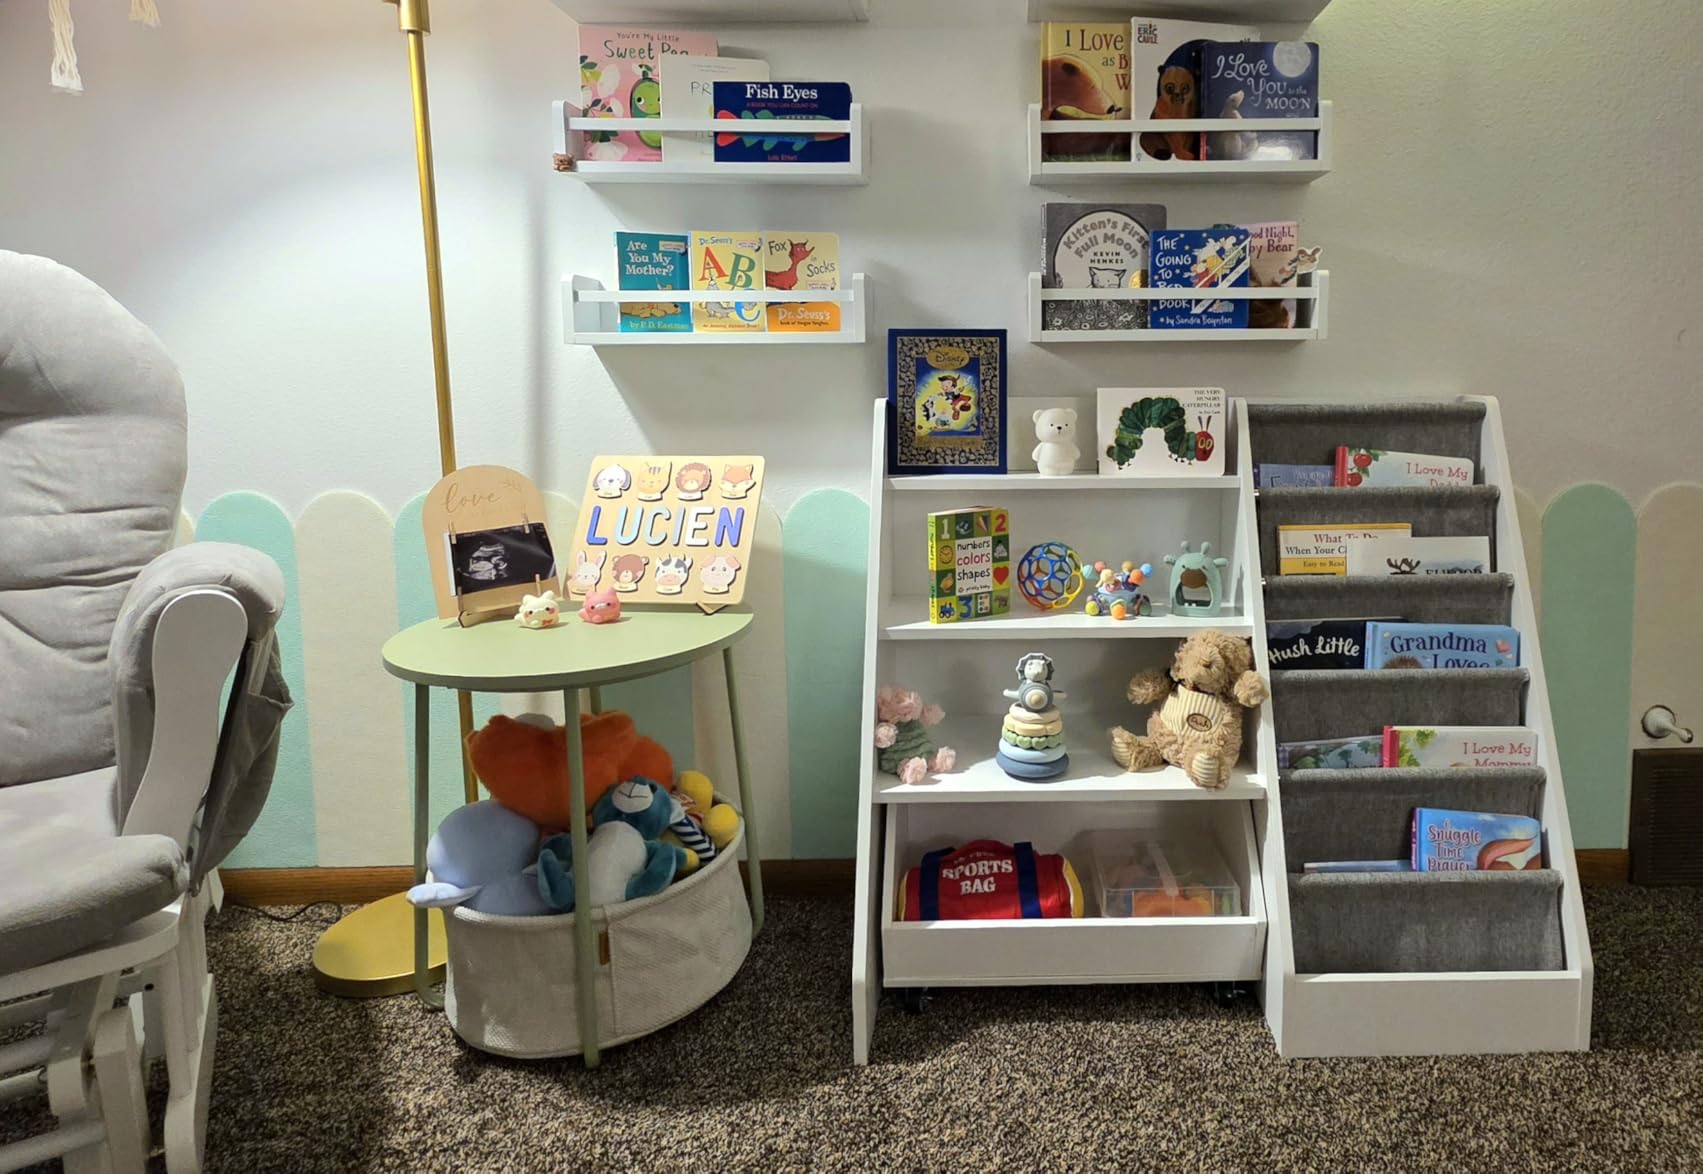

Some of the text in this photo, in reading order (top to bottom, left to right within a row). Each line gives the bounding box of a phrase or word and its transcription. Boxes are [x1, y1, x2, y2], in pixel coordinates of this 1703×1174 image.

[616, 32, 680, 41] You're My Little
[1138, 26, 1158, 36] ERIC
[1066, 29, 1124, 51] I Love
[1138, 36, 1158, 44] CARLE
[604, 40, 655, 60] Sweet
[1102, 56, 1116, 66] as
[1224, 53, 1270, 80] Love
[745, 84, 818, 102] Fish Eyes
[1264, 98, 1310, 110] MOON
[1063, 218, 1118, 250] Kitten's
[1121, 222, 1149, 250] First
[626, 240, 647, 252] Are
[768, 240, 788, 256] Fox
[1074, 232, 1138, 258] Full Moon
[1156, 236, 1179, 251] THE
[1267, 240, 1294, 253] Bear
[628, 252, 672, 265] You My
[1156, 252, 1192, 268] GOING
[625, 264, 674, 276] Mother?
[806, 260, 836, 278] Socks
[1158, 268, 1172, 280] TO
[1159, 298, 1190, 310] BOOK
[778, 308, 830, 320] Dr. Seuss's
[1166, 314, 1232, 326] by Sandra Boynton
[1406, 462, 1468, 480] I Love My
[440, 482, 502, 514] love
[586, 506, 744, 548] LUCIEN
[942, 514, 1006, 539] 1 2
[957, 540, 990, 551] numbers
[1314, 534, 1342, 544] What
[1286, 546, 1311, 555] When
[1314, 546, 1335, 554] Your
[957, 552, 990, 566] colors
[1304, 560, 1317, 568] Easy
[957, 568, 990, 582] shapes
[960, 596, 973, 618] 3
[1269, 636, 1360, 664] Hush Little
[1390, 632, 1487, 654] Grandma
[1464, 742, 1532, 757] I Love My
[1428, 824, 1481, 847] Snuggle
[1435, 842, 1464, 858] Time
[942, 859, 1013, 880] SPORTS
[960, 876, 996, 896] BAG
